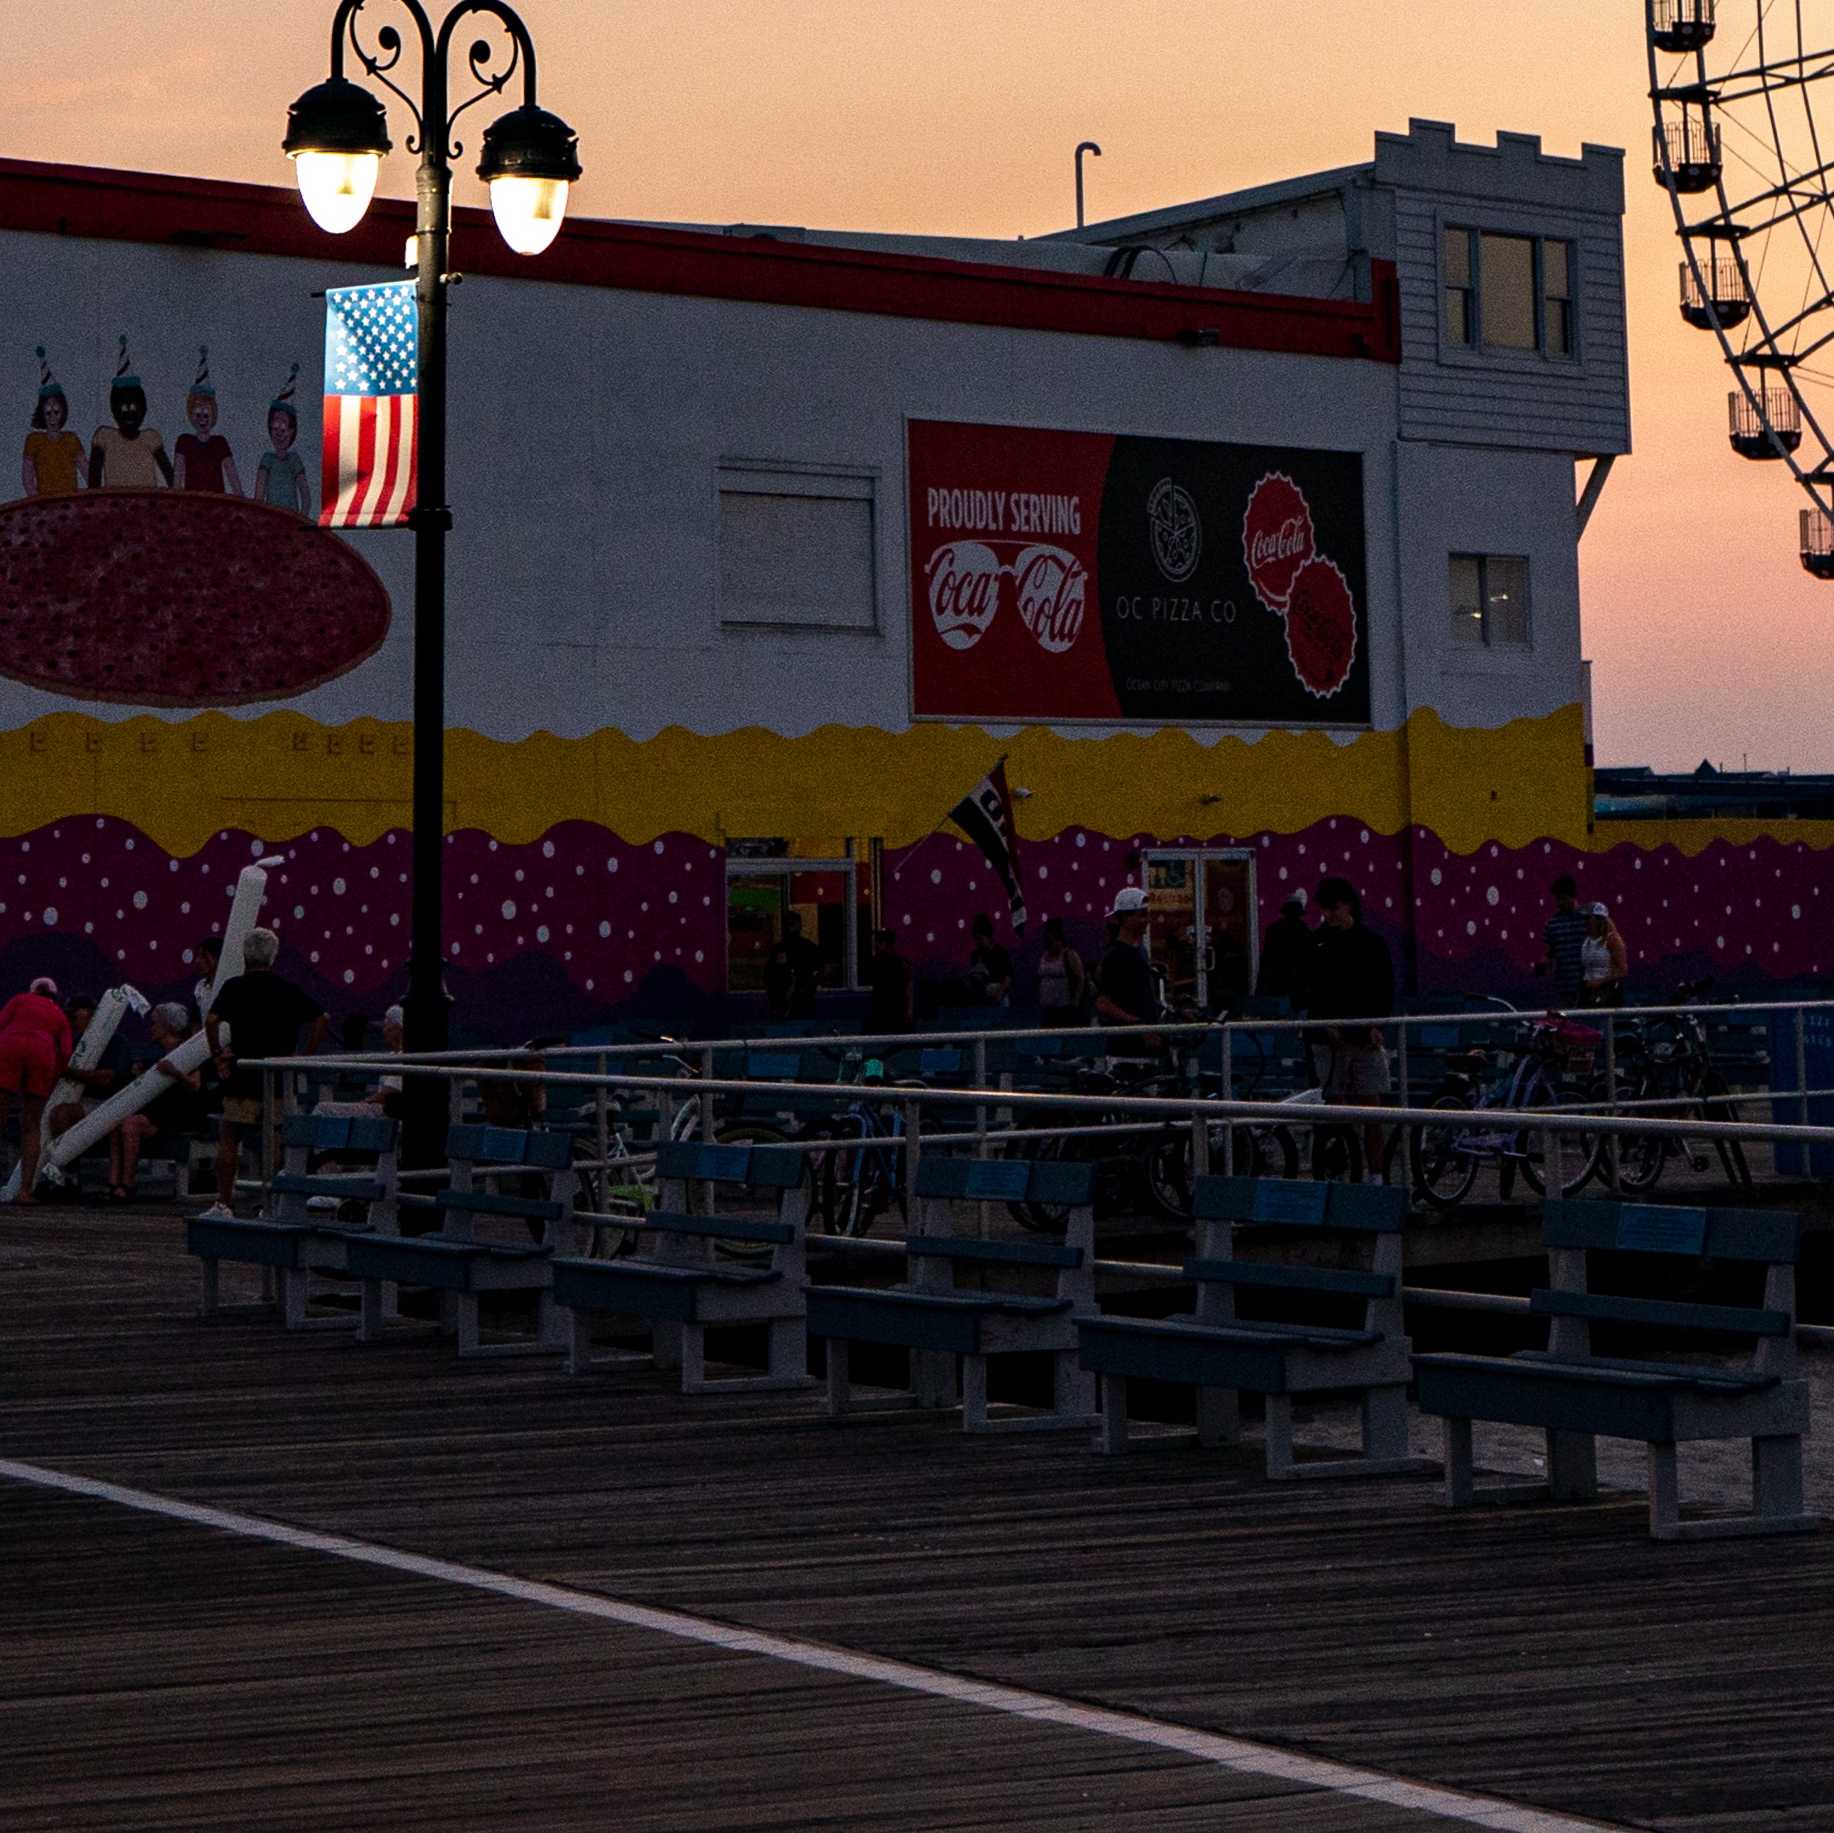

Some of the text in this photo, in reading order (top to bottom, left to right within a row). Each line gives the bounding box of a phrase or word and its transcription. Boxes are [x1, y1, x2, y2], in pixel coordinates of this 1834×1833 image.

[926, 486, 1082, 536] PROUDLY SERVING
[1116, 595, 1237, 624] OC PIZZA CO
